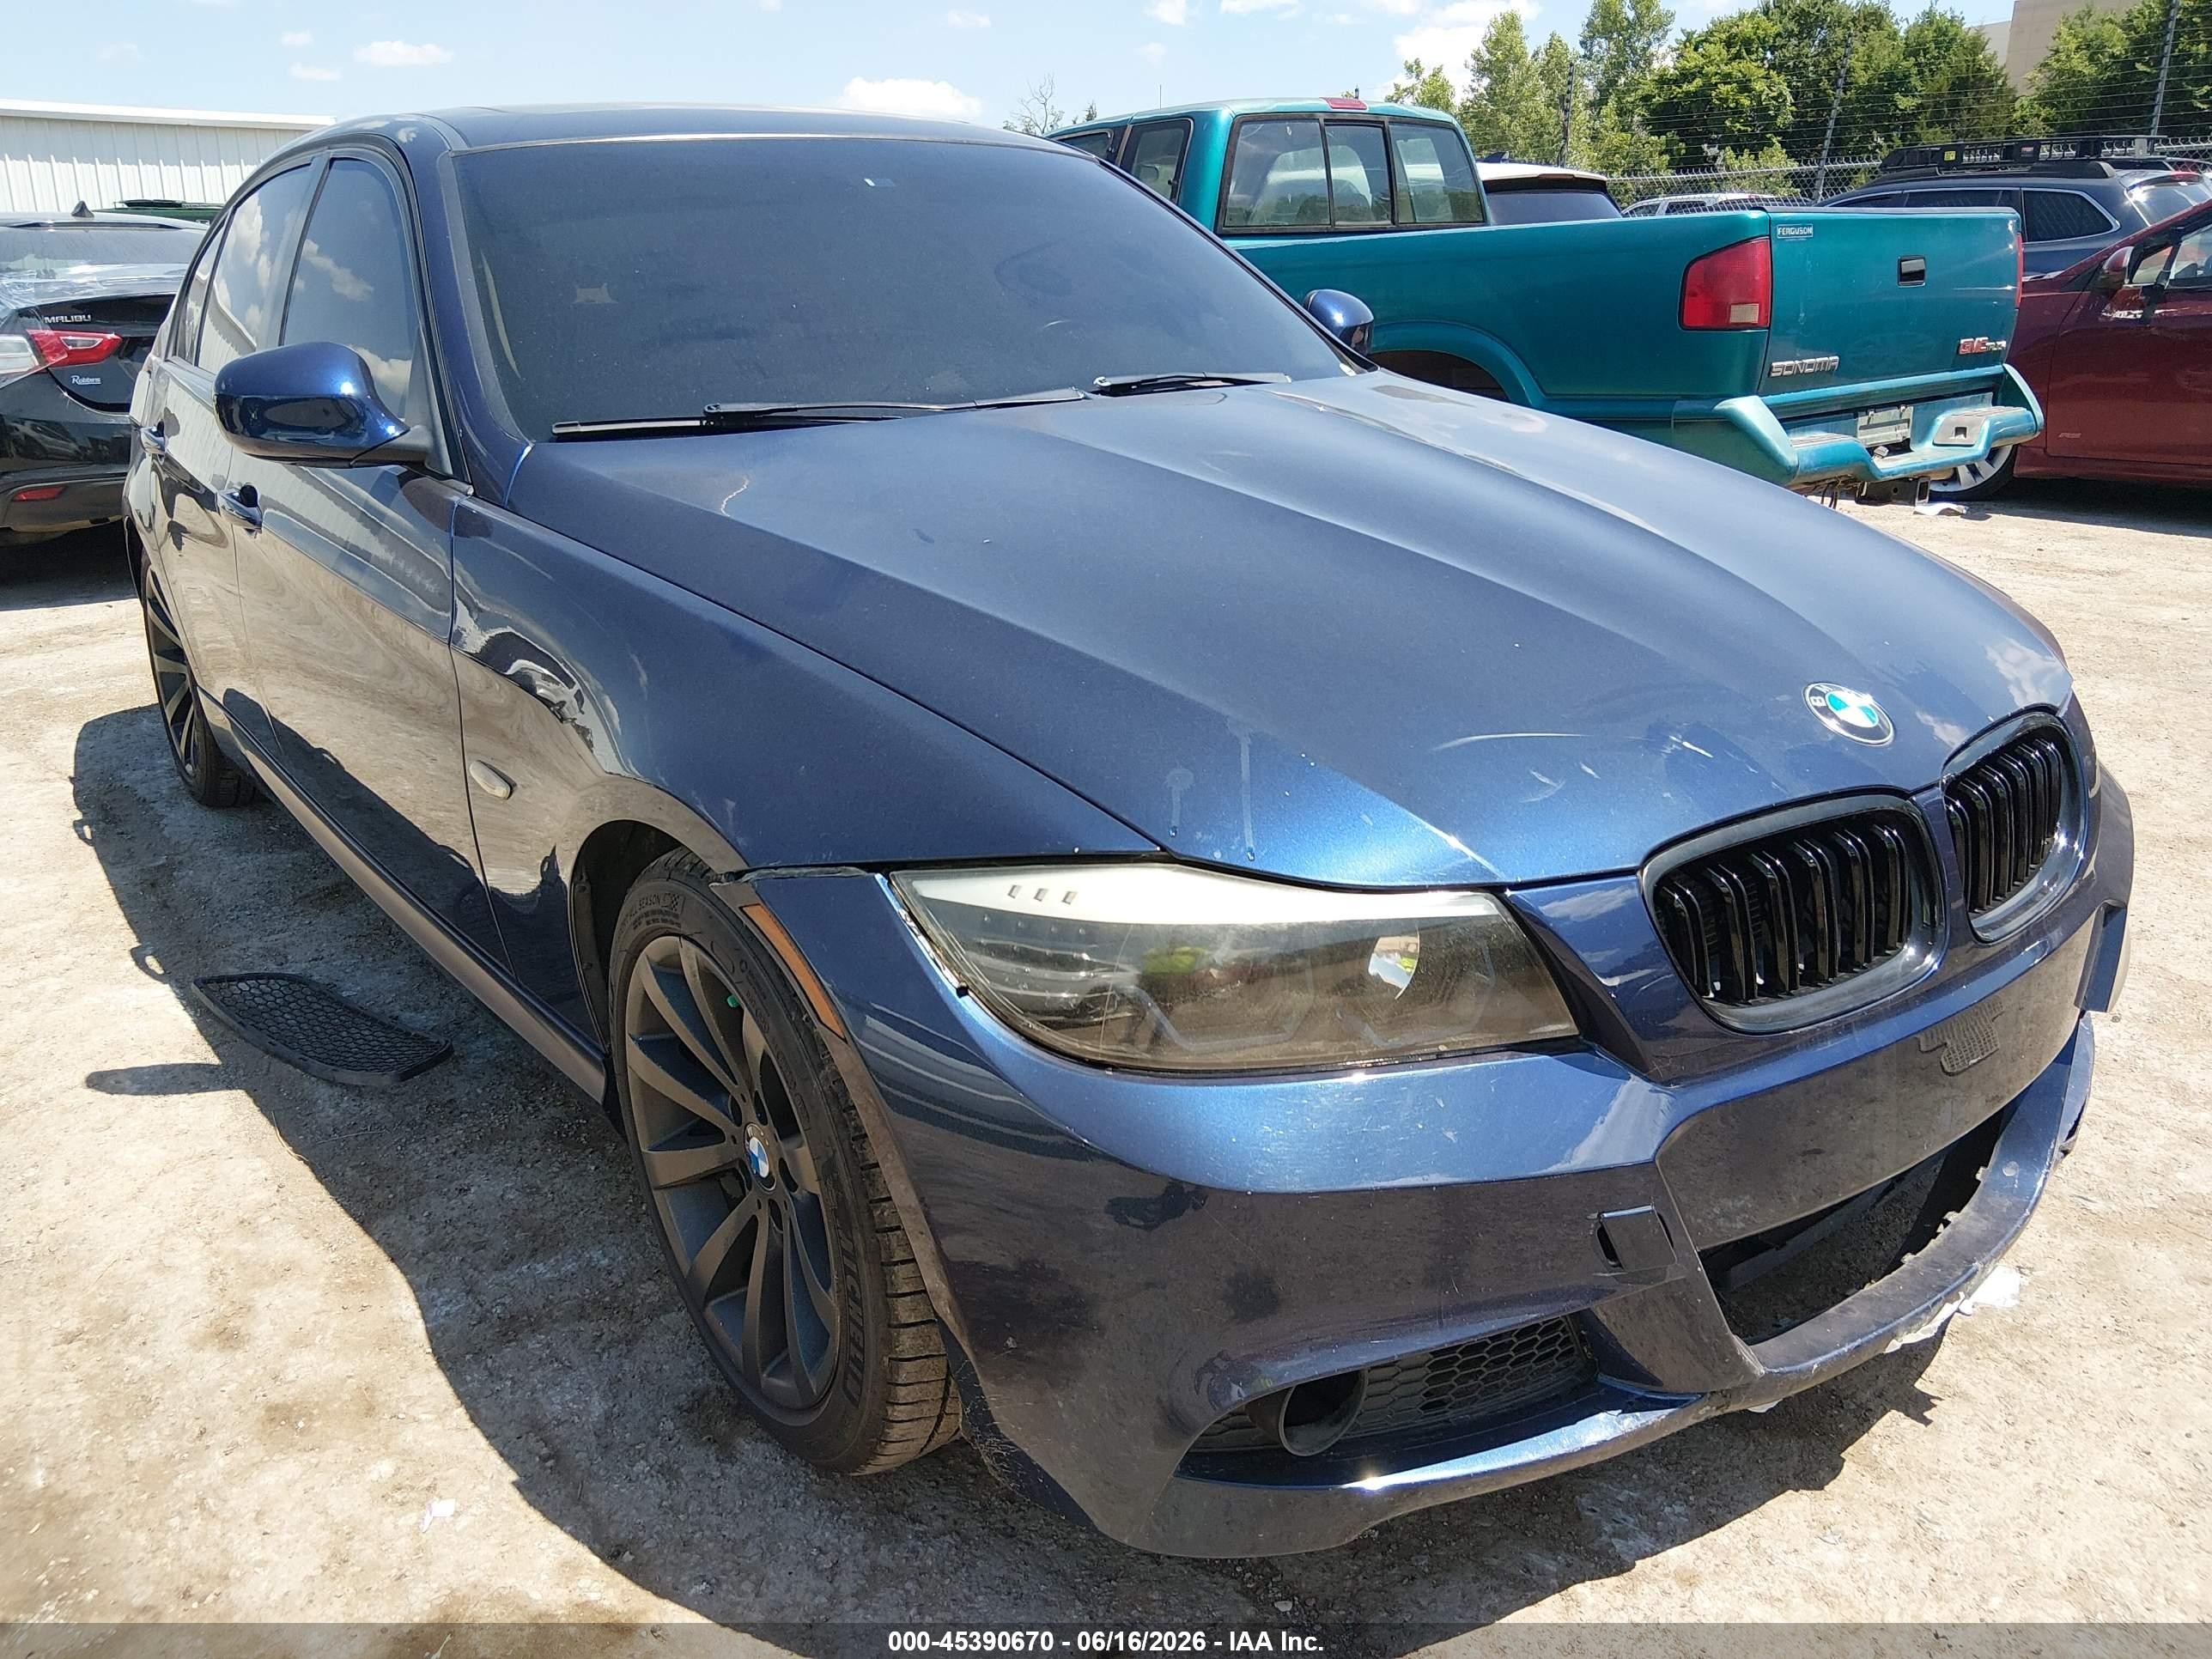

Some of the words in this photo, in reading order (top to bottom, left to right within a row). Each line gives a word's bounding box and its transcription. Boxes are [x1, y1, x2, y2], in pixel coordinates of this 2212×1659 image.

[1778, 227, 1813, 235] FERGUSON
[44, 314, 92, 324] MALIBU
[1771, 356, 1839, 378] SONOMA
